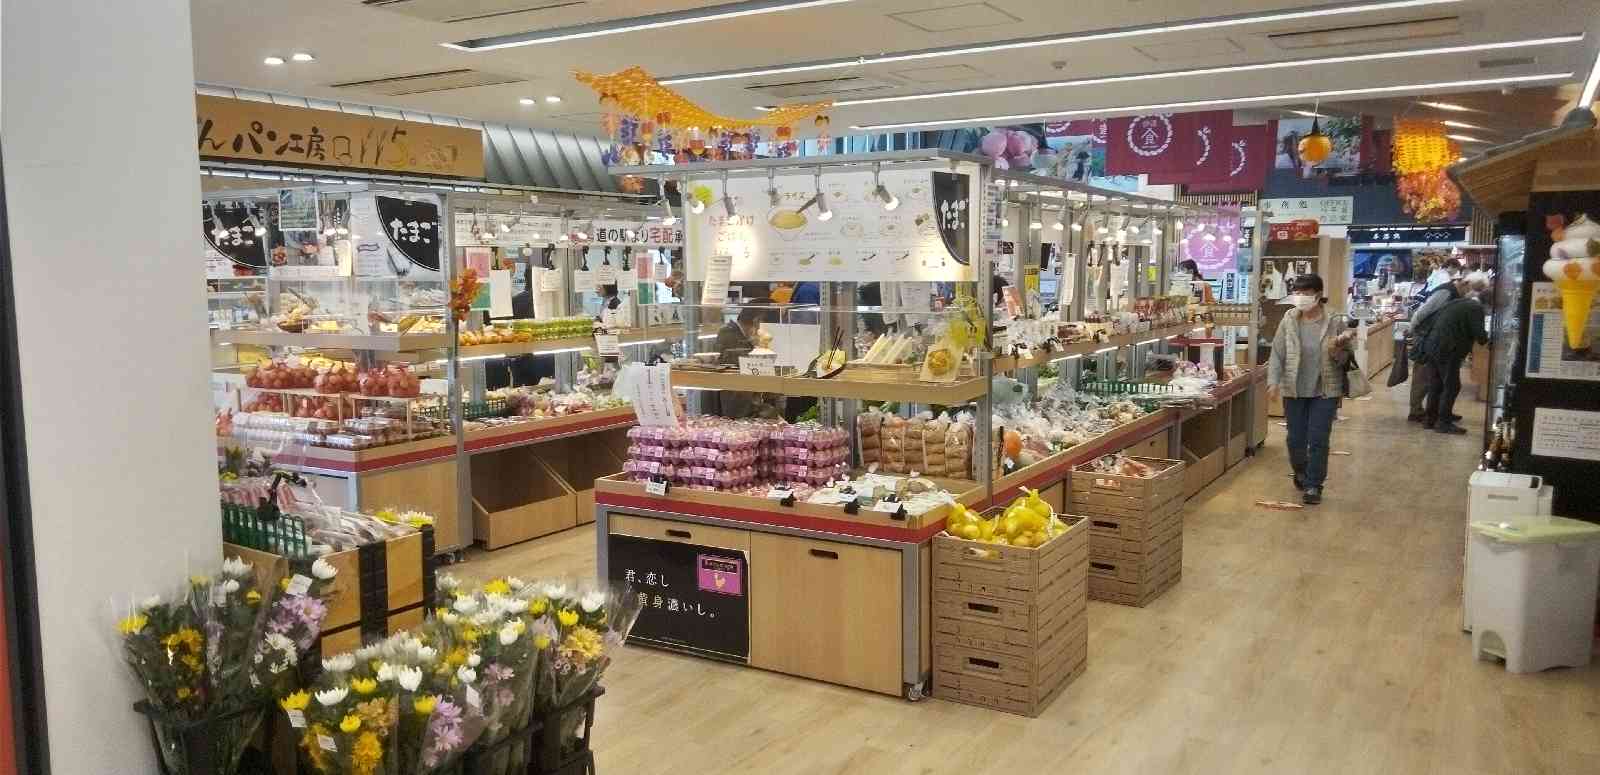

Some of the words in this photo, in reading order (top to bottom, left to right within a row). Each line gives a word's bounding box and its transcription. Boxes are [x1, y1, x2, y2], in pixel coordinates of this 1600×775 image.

[390, 217, 437, 244] たまご
[625, 569, 670, 588] 君、恋し
